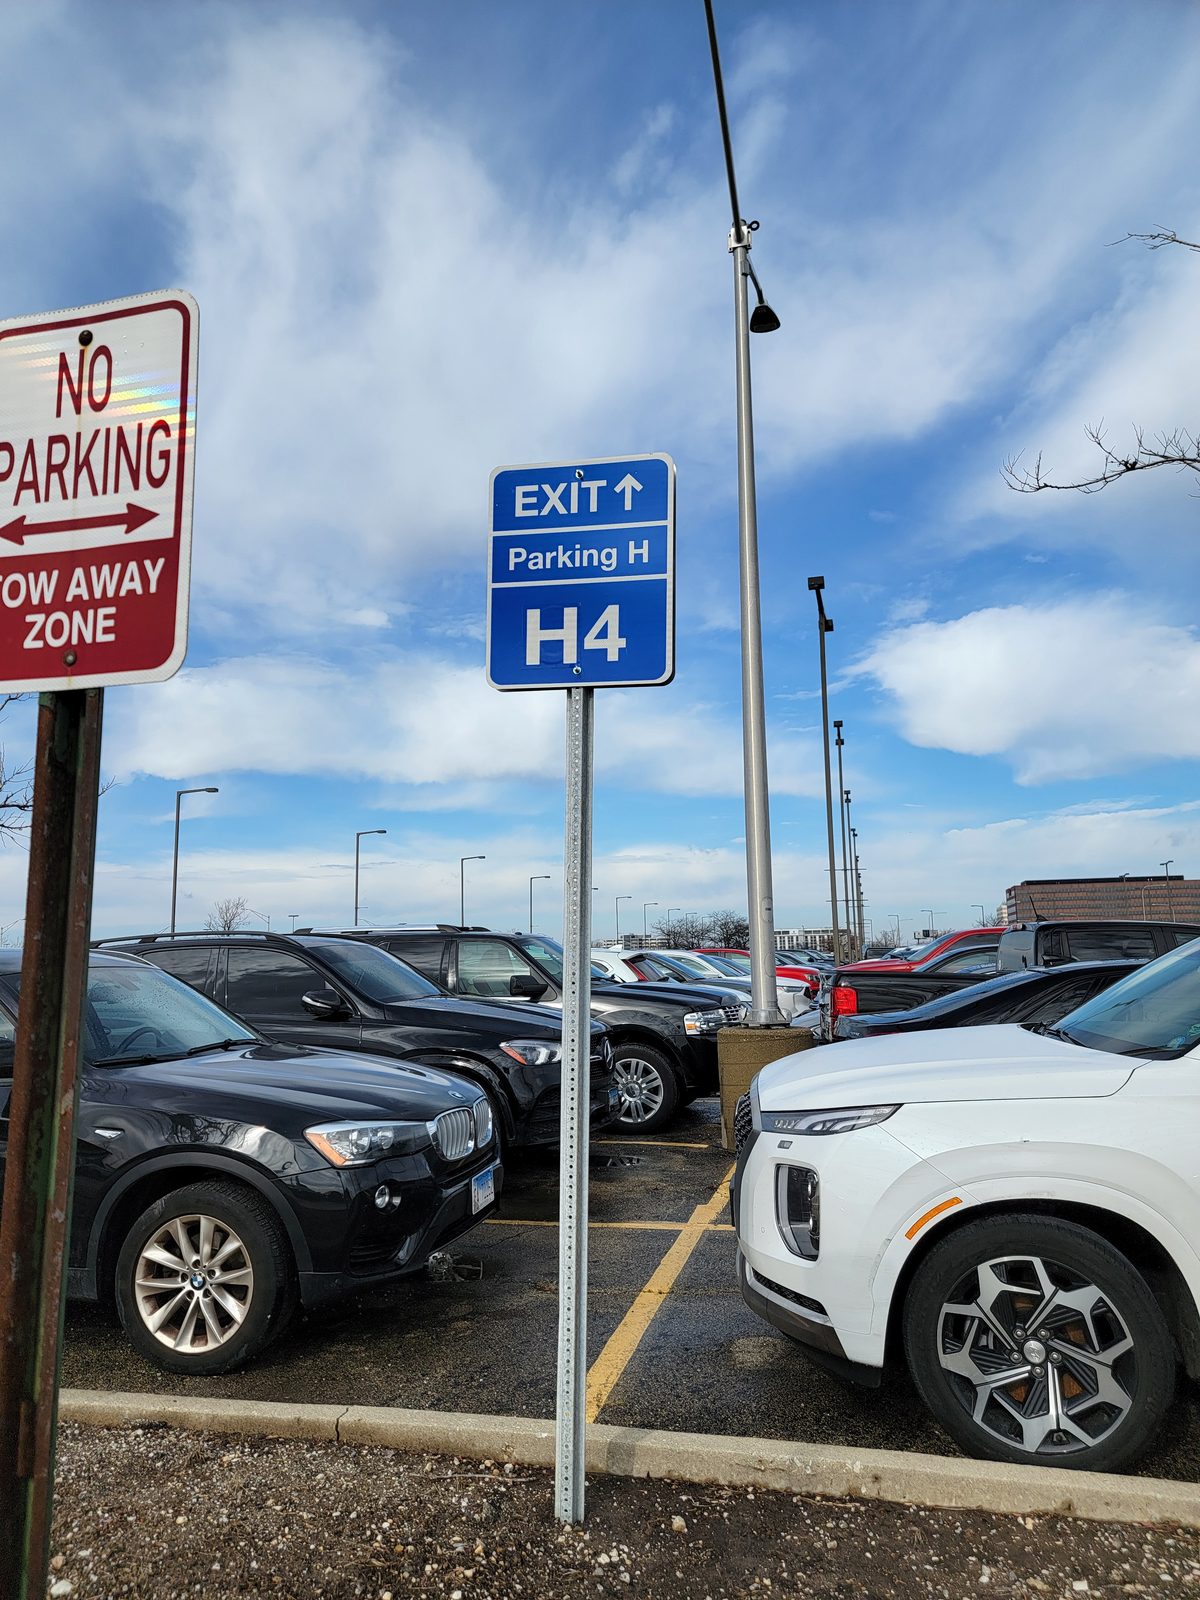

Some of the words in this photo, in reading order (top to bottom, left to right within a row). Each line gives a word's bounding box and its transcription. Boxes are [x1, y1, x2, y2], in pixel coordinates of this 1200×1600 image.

[56, 345, 113, 418] NO
[514, 480, 607, 517] EXIT
[508, 544, 617, 571] Parking
[628, 540, 649, 564] H
[0, 570, 59, 608] OW
[66, 558, 165, 603] AWAY
[22, 606, 117, 650] ZONE
[525, 604, 627, 666] H4
